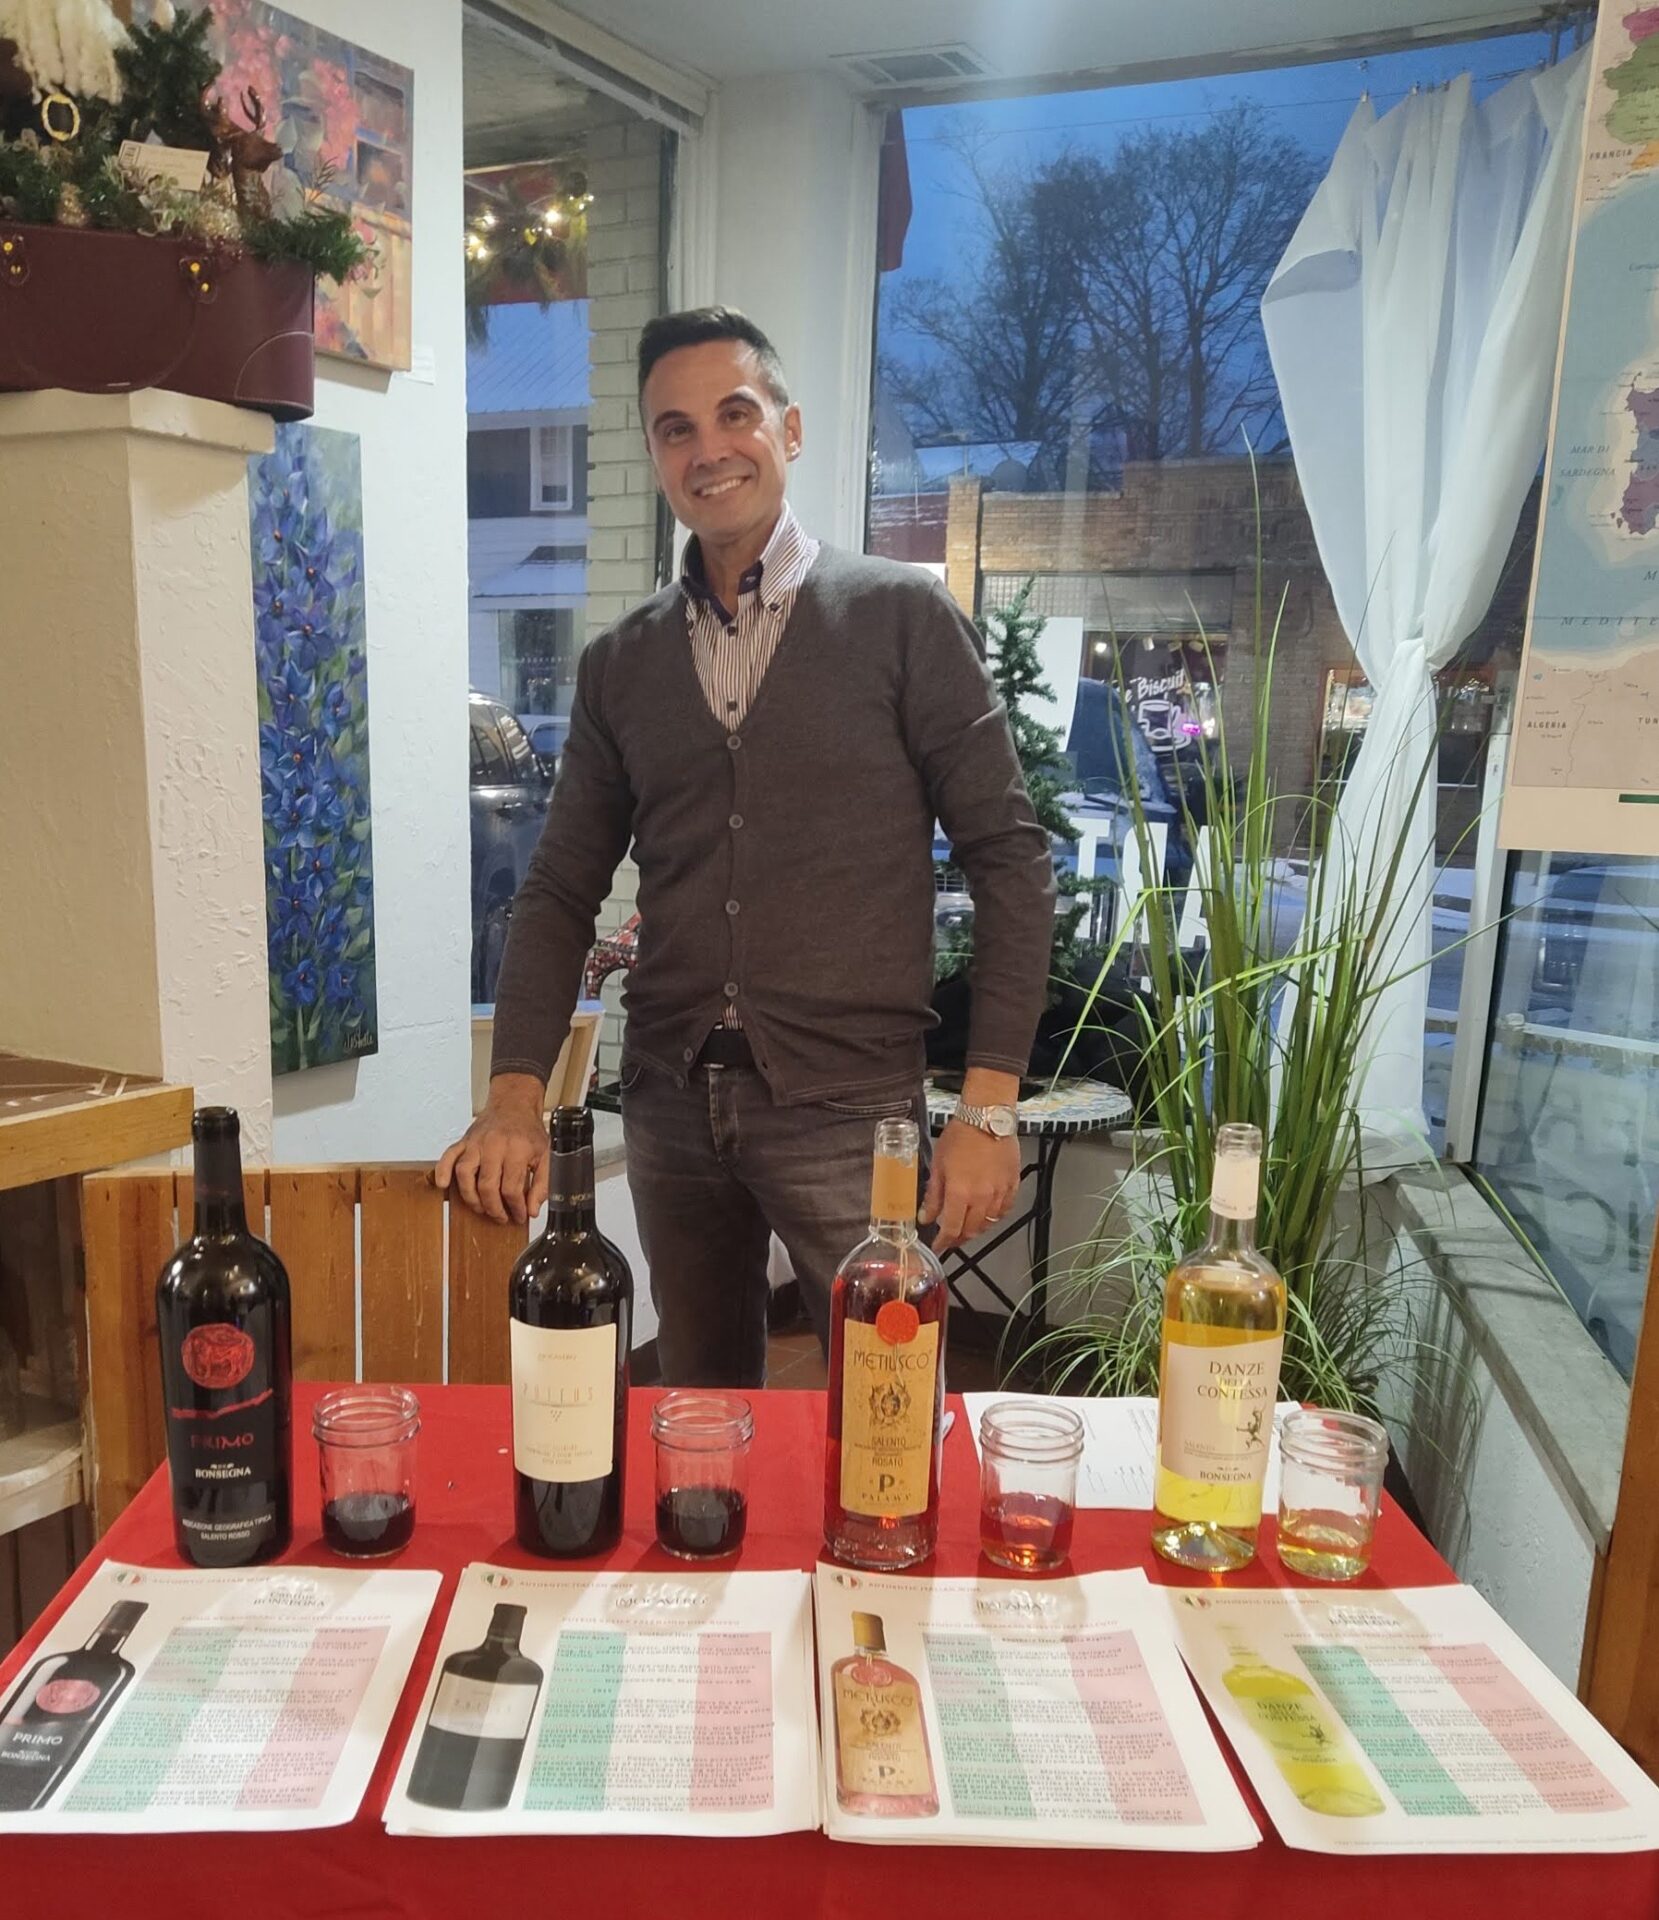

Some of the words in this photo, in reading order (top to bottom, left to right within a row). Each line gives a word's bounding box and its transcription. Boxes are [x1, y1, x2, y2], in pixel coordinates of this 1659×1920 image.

[1570, 445, 1595, 454] MAR
[1560, 468, 1616, 477] SARDEGNA
[1527, 721, 1567, 729] ALGERIA
[1209, 1361, 1265, 1376] DANZE
[1197, 1385, 1268, 1401] CONTESSA
[190, 1433, 254, 1450] PRIMO
[195, 1466, 252, 1479] BONSEGNA
[1200, 1470, 1252, 1481] BONSEGNA
[880, 1473, 895, 1493] P
[200, 1531, 228, 1541] SALENTO
[12, 1731, 64, 1746] PRIMO
